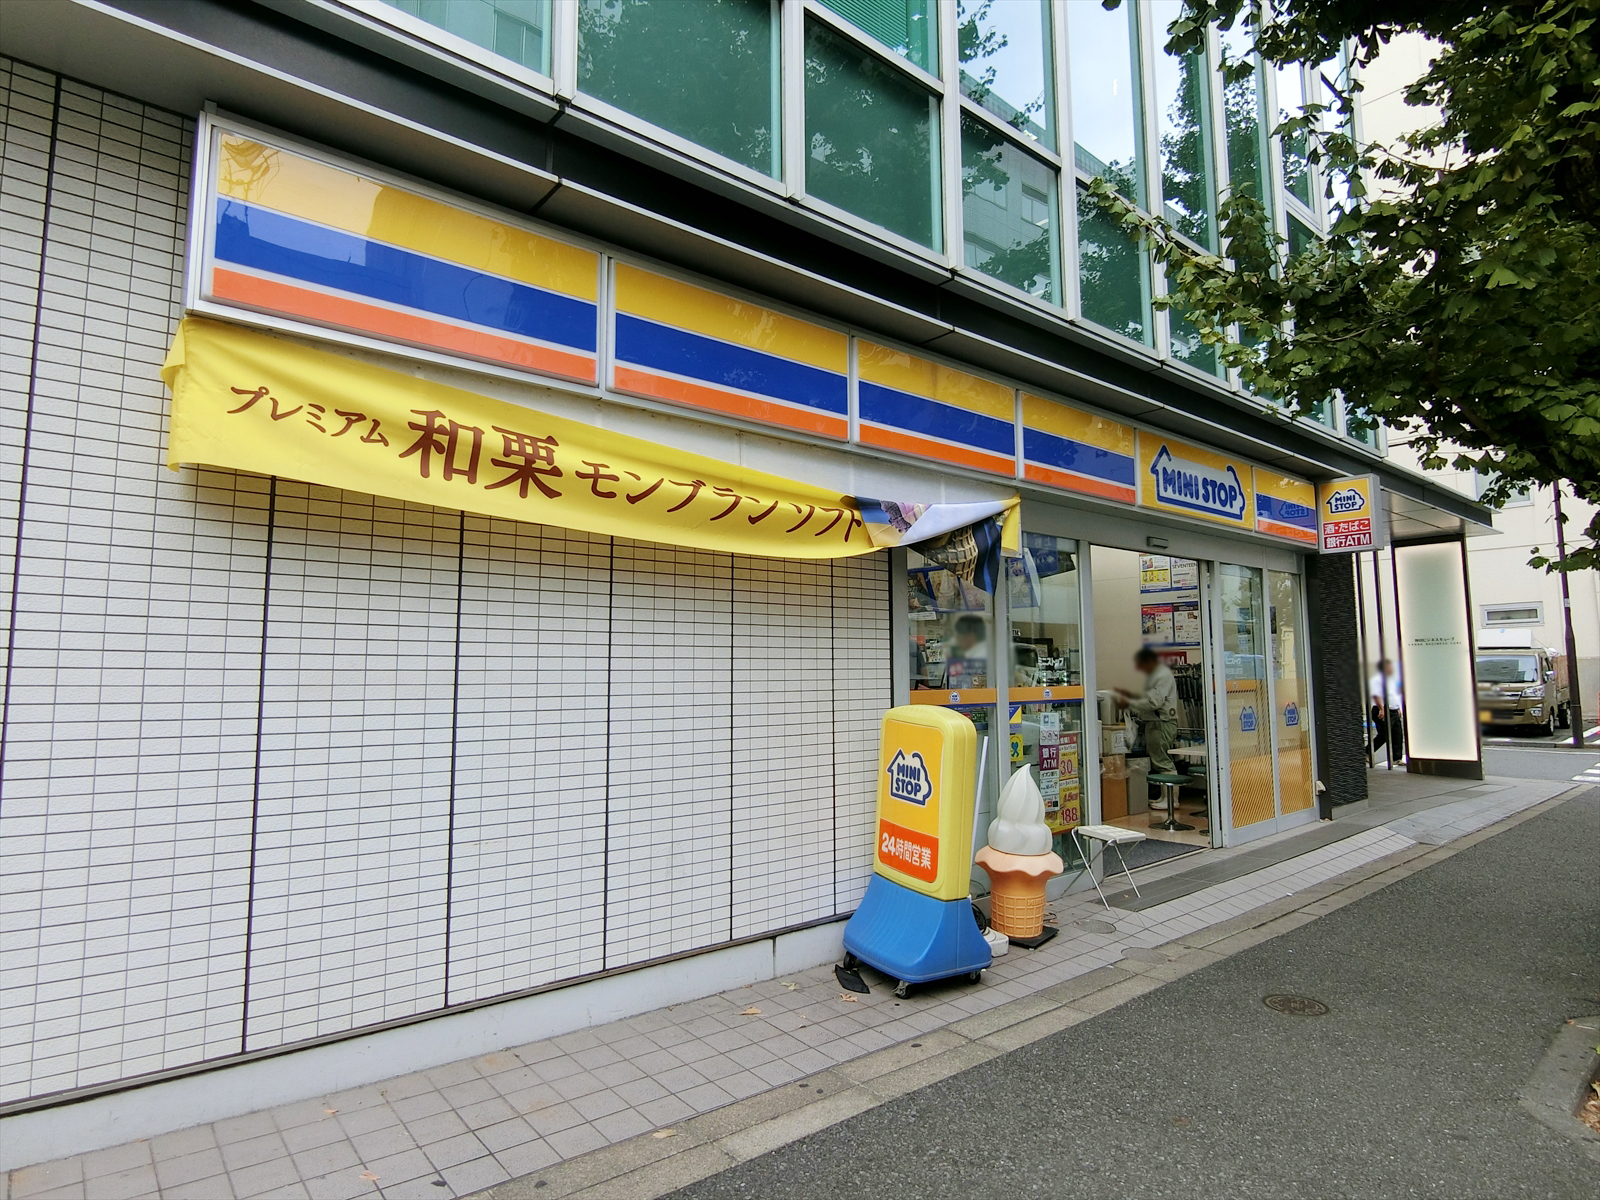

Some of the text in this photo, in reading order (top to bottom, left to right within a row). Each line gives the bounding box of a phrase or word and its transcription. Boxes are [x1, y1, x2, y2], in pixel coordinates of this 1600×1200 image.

[227, 385, 390, 448] プレミアム
[398, 408, 565, 500] 和栗
[1162, 466, 1238, 509] MINI STOP
[1334, 494, 1356, 503] MINI
[1334, 501, 1358, 511] STOP
[1326, 533, 1370, 548] 銀行ATM
[1042, 747, 1057, 759] 銀行
[897, 762, 921, 782] MINI
[1042, 759, 1057, 769] ATM
[1060, 758, 1073, 777] 30
[894, 777, 922, 797] STOP
[881, 831, 932, 870] 24時間営業
